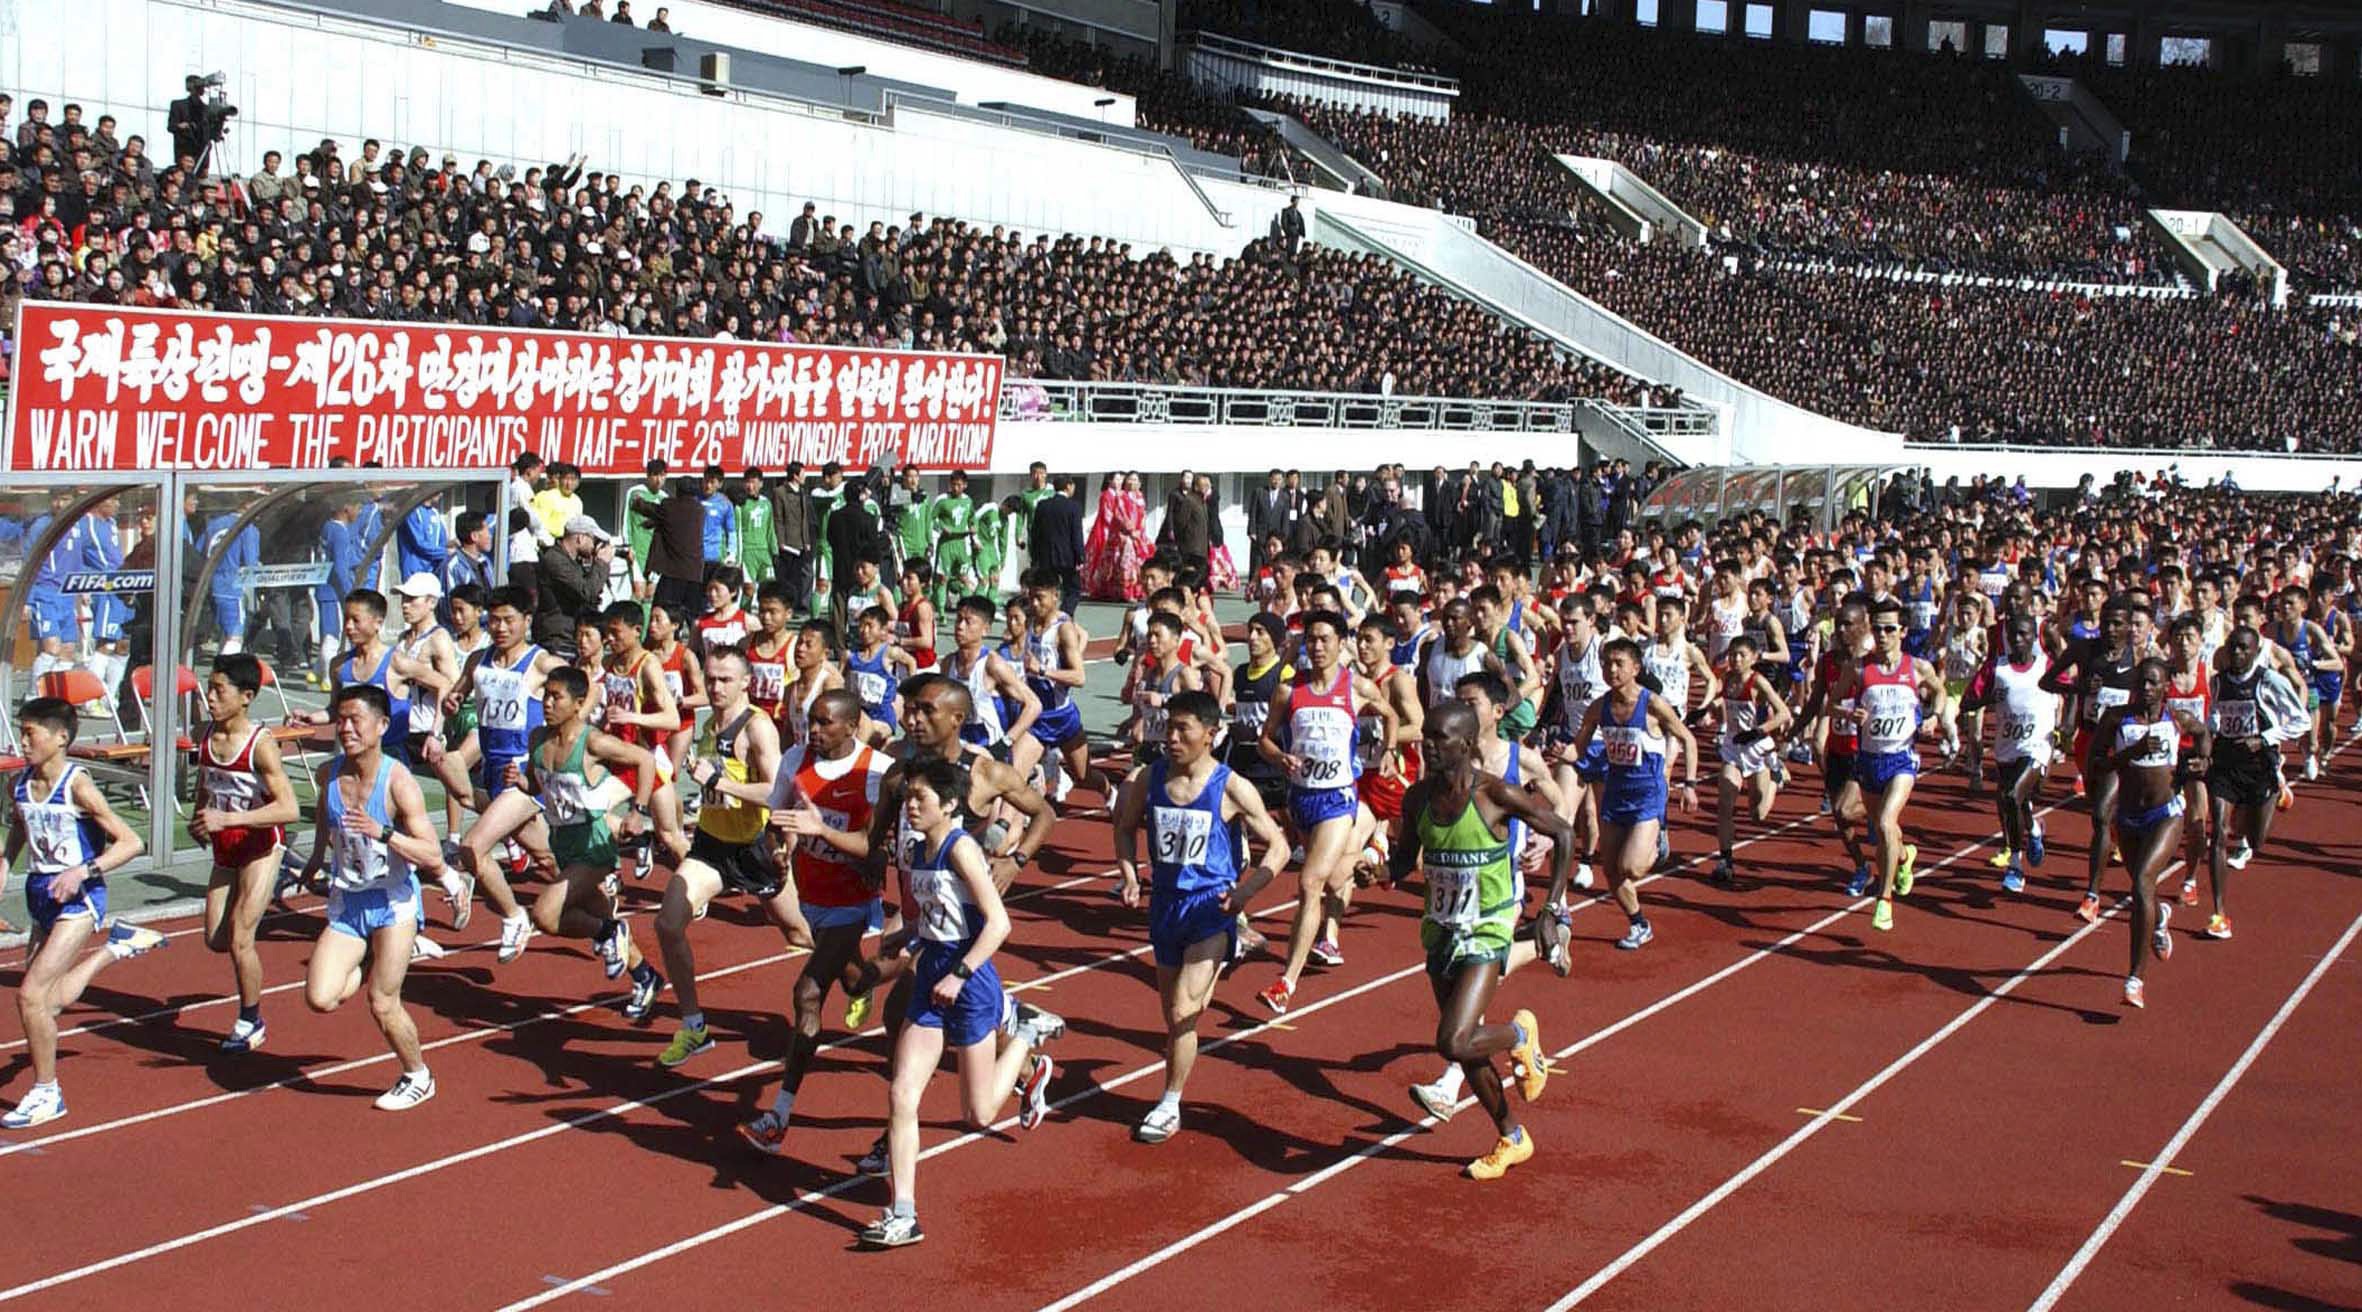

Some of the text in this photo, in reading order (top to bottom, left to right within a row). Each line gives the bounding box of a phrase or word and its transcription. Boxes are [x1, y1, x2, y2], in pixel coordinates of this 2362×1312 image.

[30, 408, 118, 470] WARM
[136, 411, 274, 470] WELCOME
[289, 414, 344, 468] THE
[355, 414, 528, 467] PARTICIPANTS
[539, 416, 564, 466] IN
[741, 420, 858, 466] MANGYONGDAE
[858, 422, 902, 465] PRIZE
[906, 424, 990, 465] MARATHON!
[67, 573, 154, 591] FIFA.com
[1565, 682, 1592, 701] 302
[481, 700, 519, 725] 130
[1870, 717, 1906, 738] 307
[1301, 759, 1341, 780] 308
[1160, 831, 1206, 862] 310
[1434, 886, 1473, 919] 311
